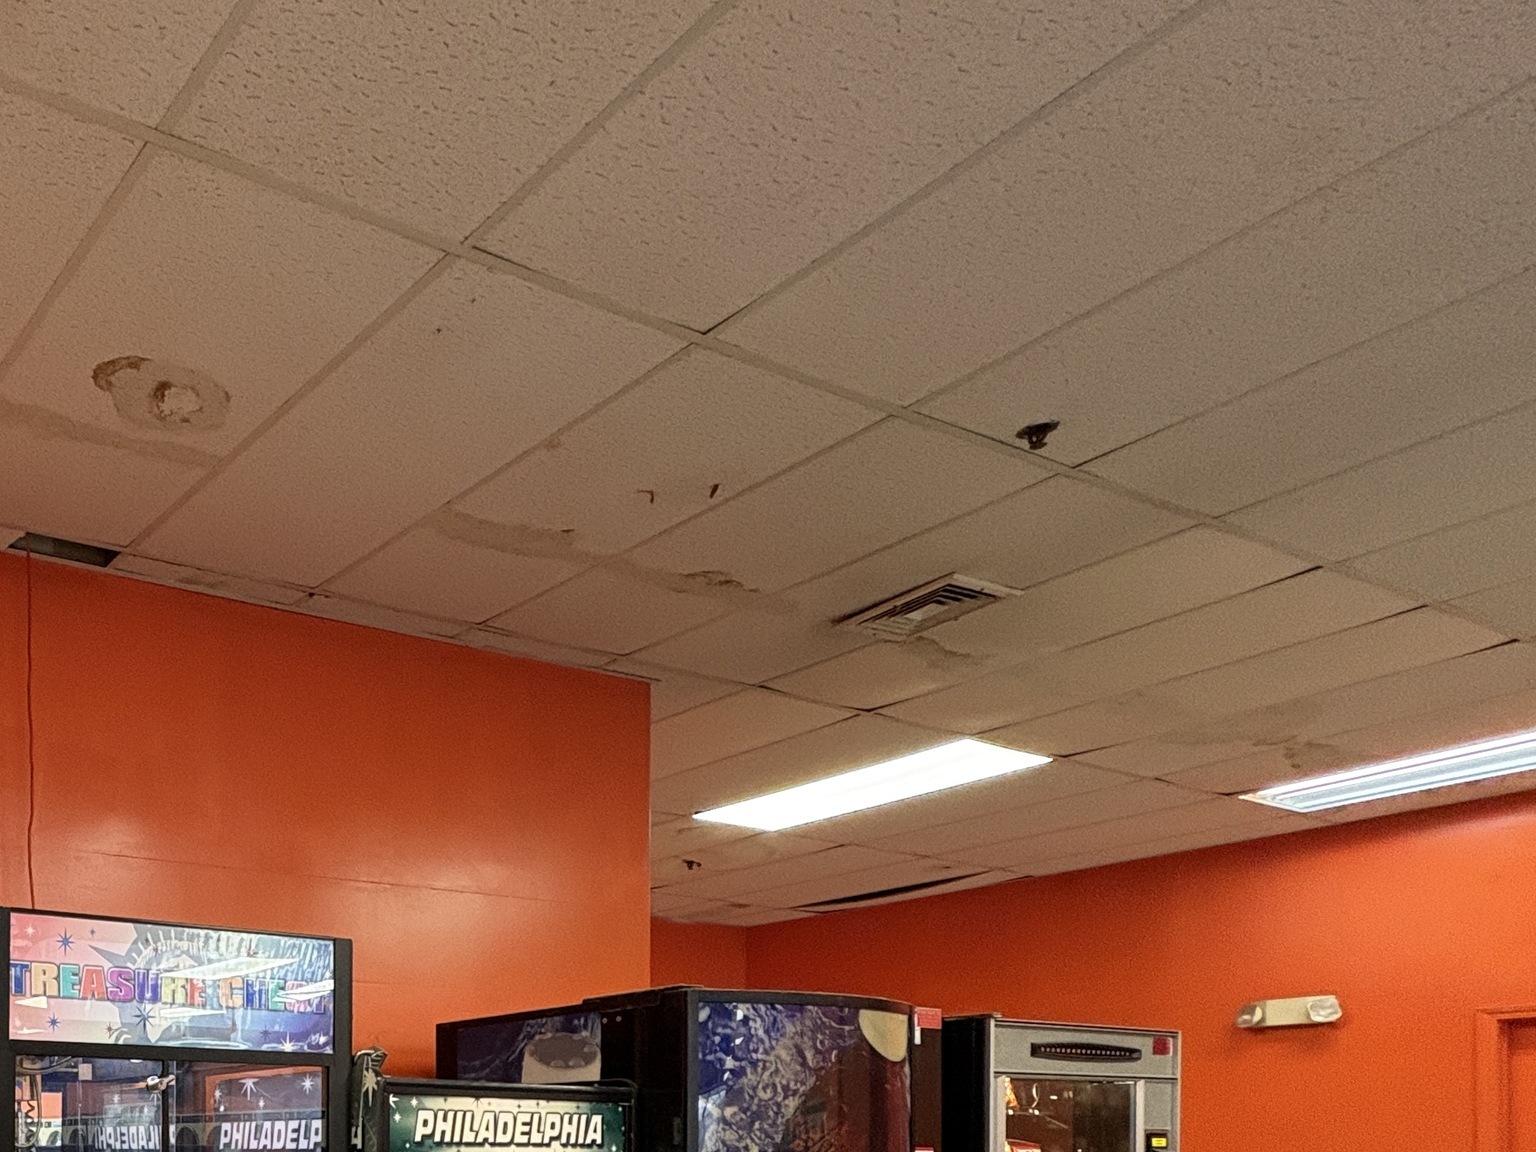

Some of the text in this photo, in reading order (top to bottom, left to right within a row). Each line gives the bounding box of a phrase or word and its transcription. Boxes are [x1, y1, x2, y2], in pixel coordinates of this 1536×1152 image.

[10, 961, 207, 1009] TREASURE
[219, 1119, 322, 1150] PHILADELP
[413, 1108, 604, 1146] PHILADELPHIA
